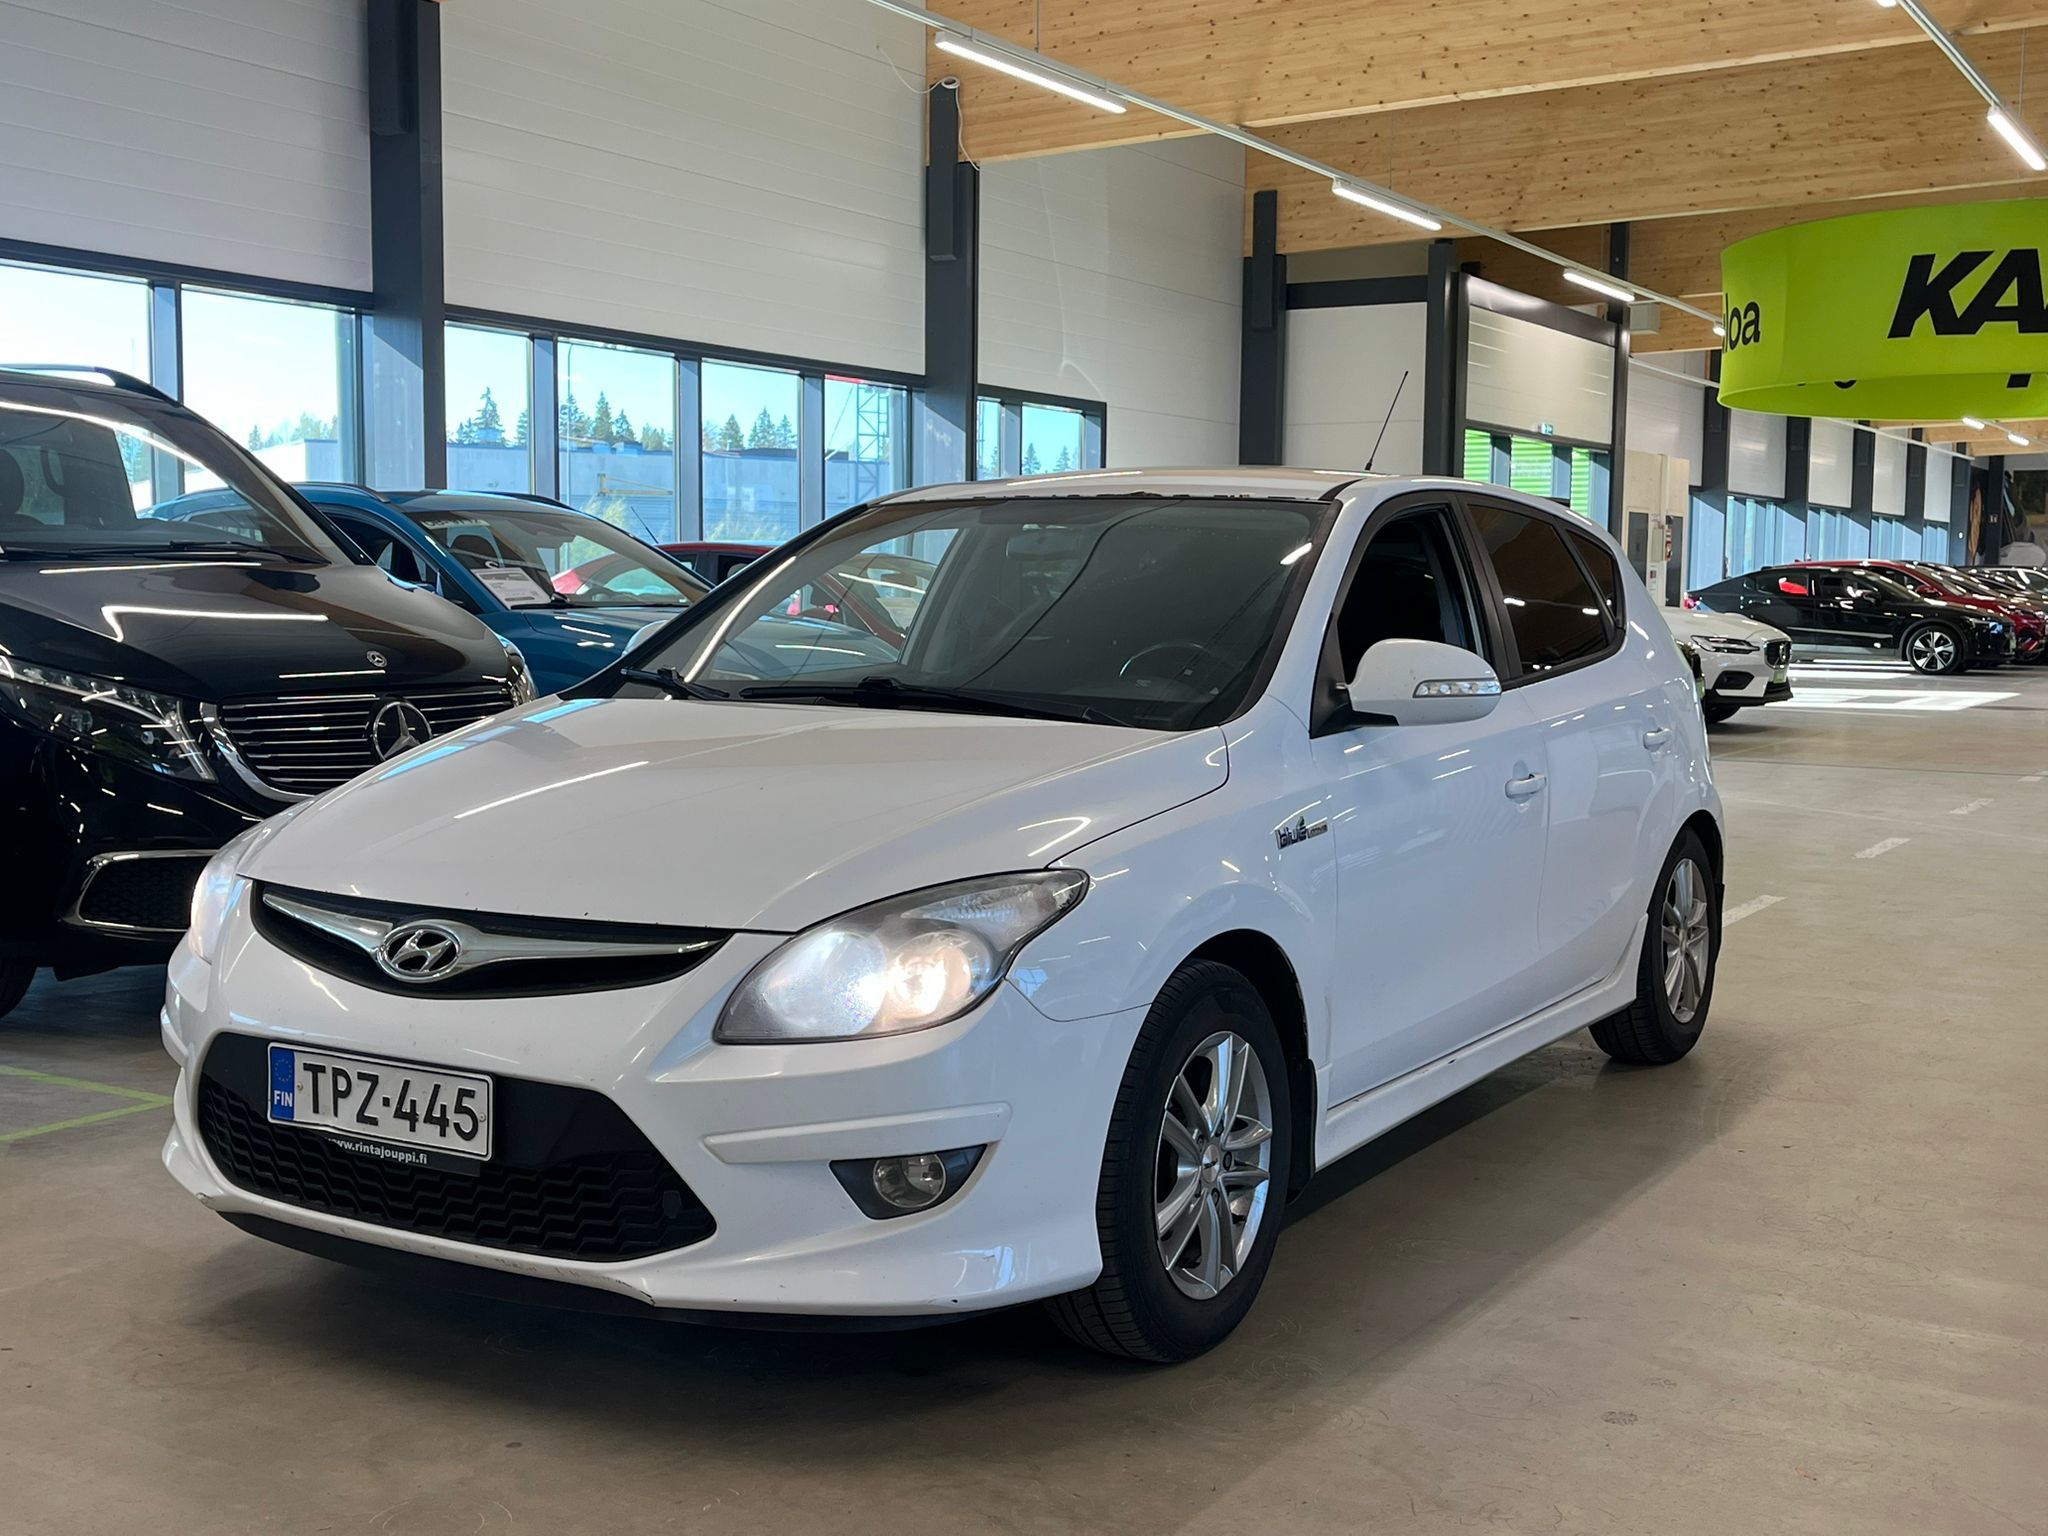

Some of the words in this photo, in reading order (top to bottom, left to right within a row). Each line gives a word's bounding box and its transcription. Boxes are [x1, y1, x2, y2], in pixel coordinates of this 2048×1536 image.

[1888, 248, 2048, 339] KA
[274, 1089, 293, 1107] FIN
[303, 1062, 479, 1142] TPZ-445
[325, 1137, 428, 1165] ww.rintajouppi.fi
